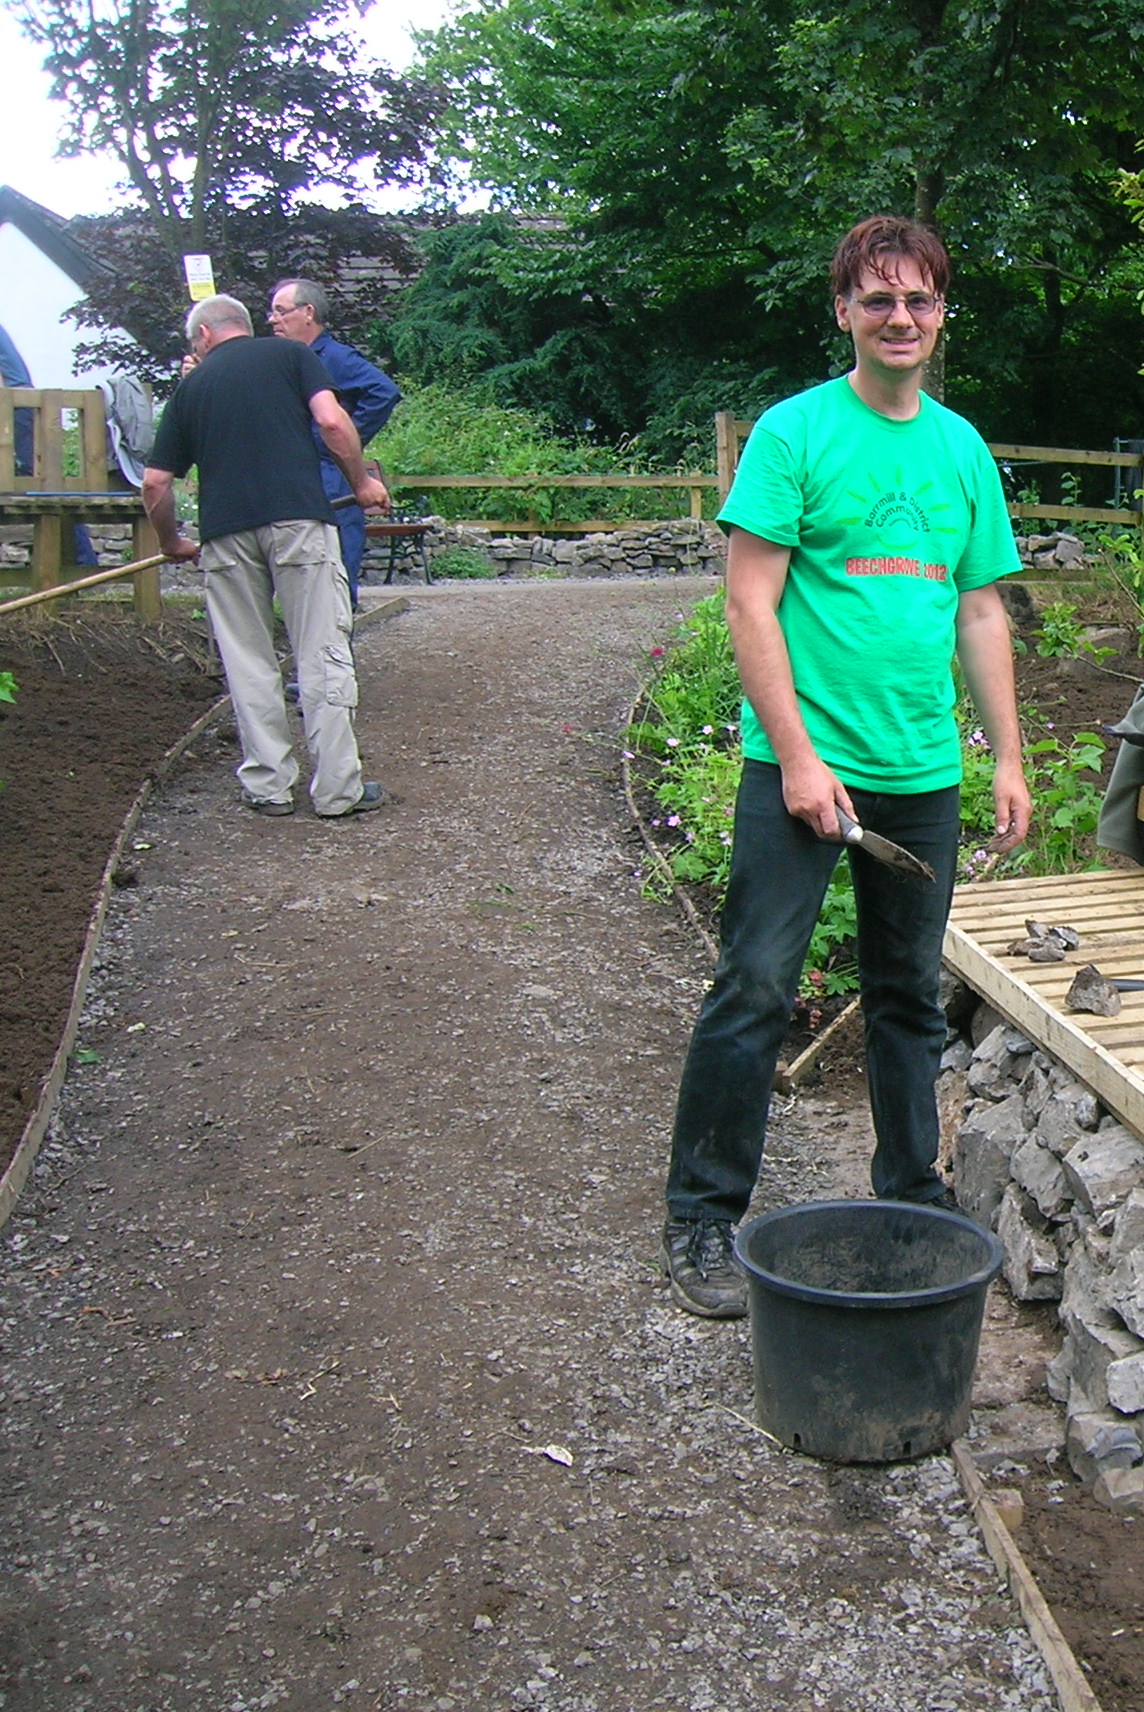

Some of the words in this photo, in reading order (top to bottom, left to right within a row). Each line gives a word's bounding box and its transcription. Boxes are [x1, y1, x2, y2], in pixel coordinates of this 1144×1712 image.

[864, 492, 896, 527] Barrmill
[899, 491, 907, 501] &
[909, 497, 931, 533] District
[875, 505, 919, 531] Community
